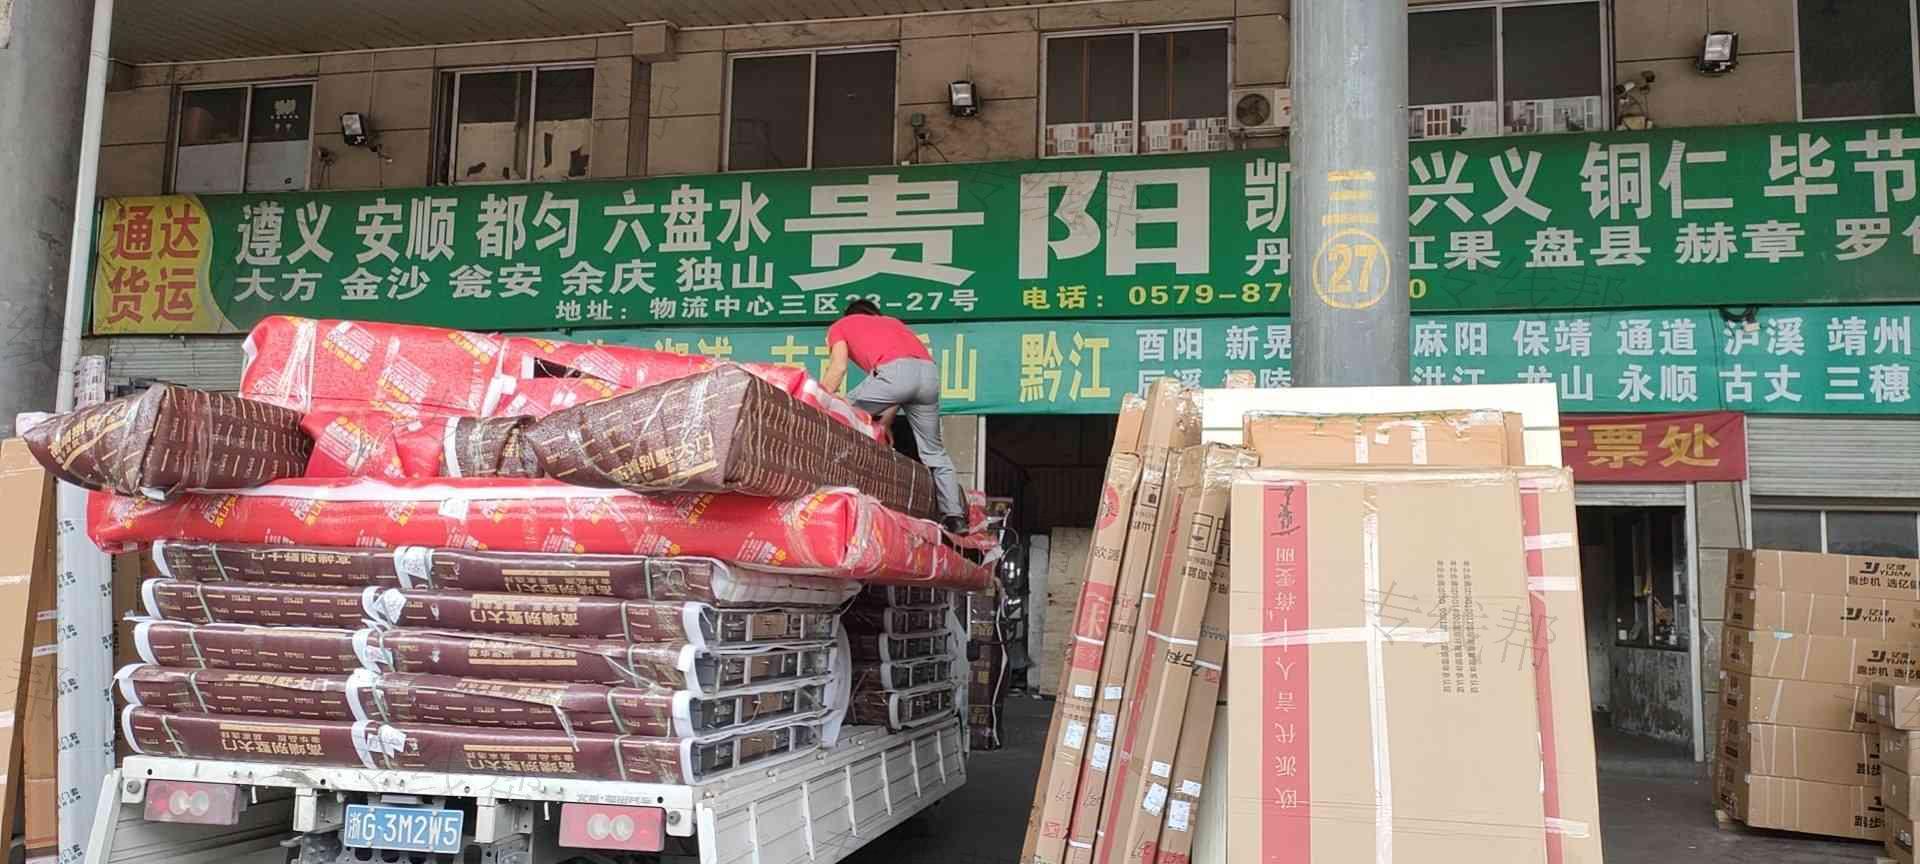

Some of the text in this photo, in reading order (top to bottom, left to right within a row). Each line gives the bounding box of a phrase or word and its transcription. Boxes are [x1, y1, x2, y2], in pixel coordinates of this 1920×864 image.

[1409, 147, 1552, 226] 兴义
[1579, 139, 1734, 220] 铜仁
[1764, 128, 1920, 213] 毕节
[111, 203, 200, 260] 通达
[235, 182, 771, 265] 遵义 安顺 都匀 六盘水
[784, 167, 1211, 291] 贵阳
[1525, 225, 1651, 268] 盘县
[1675, 219, 1805, 264] 赫章
[233, 255, 774, 302] 大方 金沙 瓮安 余庆 独山
[1327, 244, 1376, 293] 27
[107, 266, 195, 324] 货运
[1128, 283, 1291, 306] 0579-87
[1136, 315, 1911, 362] 酉阳 新晃 麻阳 保靖 通道 泸溪 靖州
[1020, 330, 1111, 402] 黔江
[1617, 365, 1697, 402] 永顺
[1719, 364, 1802, 402] 古丈
[1825, 364, 1911, 402] 三穗
[1561, 424, 1719, 468] 票处
[1849, 575, 1881, 587] 跑步机
[1880, 568, 1912, 577] YIJIAN
[470, 609, 580, 626] 高端别墅大门
[1857, 665, 1889, 677] 跑步机
[222, 738, 325, 756] 高端别墅大门
[466, 759, 577, 773] 高端别墅大门
